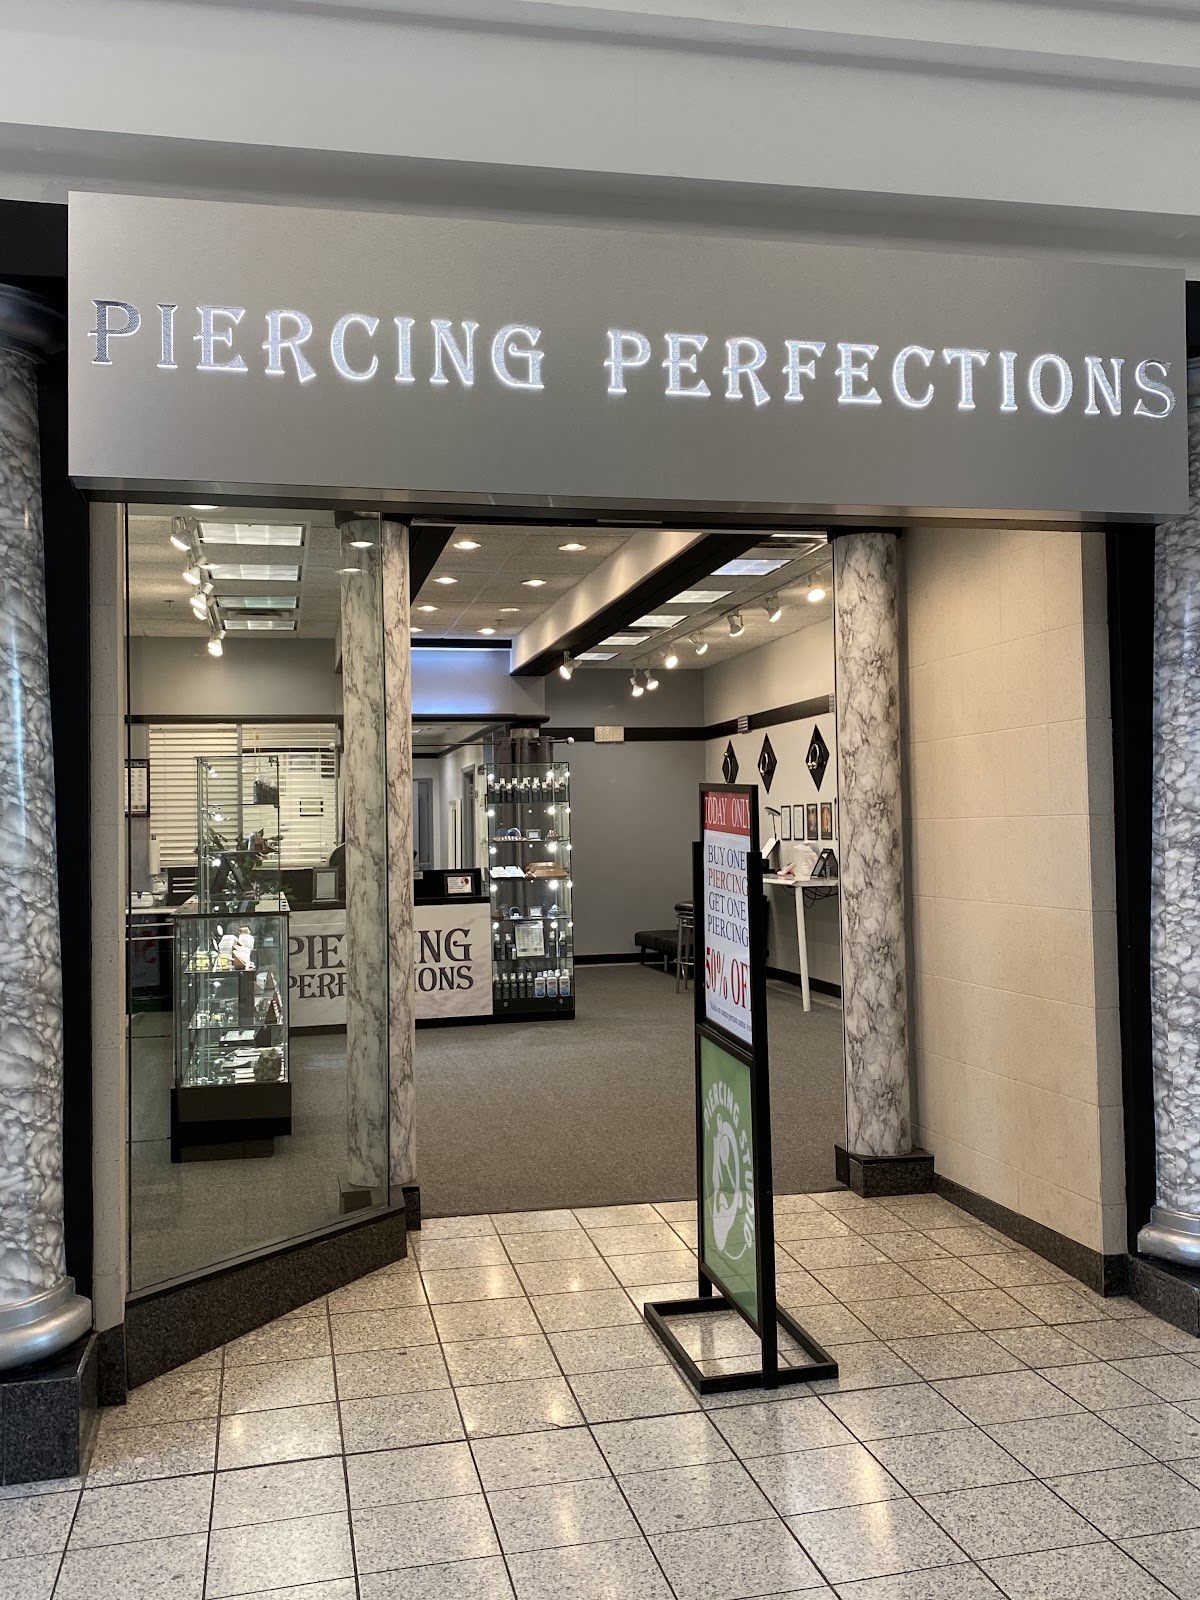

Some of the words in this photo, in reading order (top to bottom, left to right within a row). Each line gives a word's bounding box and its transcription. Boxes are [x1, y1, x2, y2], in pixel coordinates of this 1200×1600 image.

[87, 298, 545, 390] PIERCING
[604, 328, 1176, 419] PERFECTIONS
[704, 796, 727, 826] TODAY
[731, 798, 751, 829] ONLY
[707, 844, 726, 866] BUY
[726, 848, 746, 871] ONE
[708, 891, 725, 914] GET
[726, 897, 747, 922] ONE
[707, 913, 749, 948] PIERCING
[705, 946, 728, 1000] 50%
[731, 958, 752, 1011] OF
[703, 1080, 740, 1131] PIERCING
[738, 1129, 755, 1248] STUDIO
